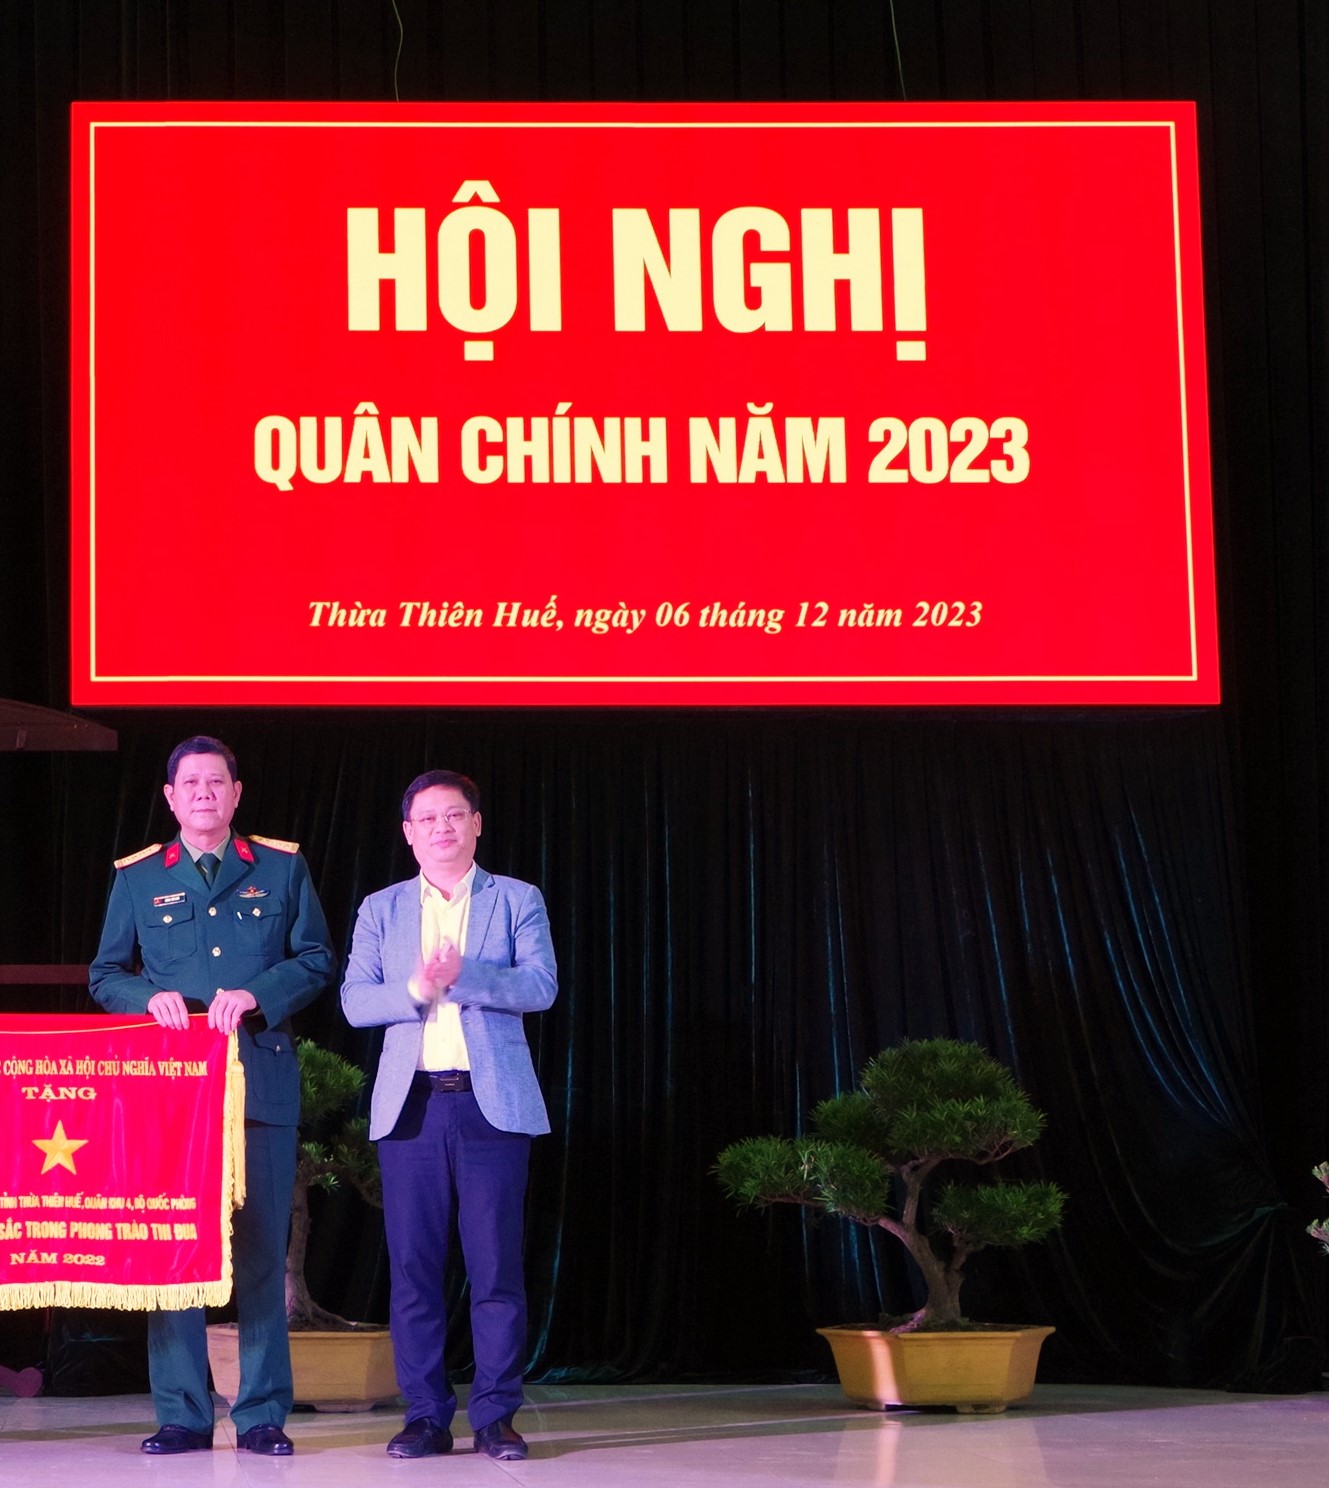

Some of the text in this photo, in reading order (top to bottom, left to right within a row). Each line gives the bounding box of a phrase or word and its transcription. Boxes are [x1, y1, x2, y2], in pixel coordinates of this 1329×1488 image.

[346, 179, 927, 362] HỘI NGHỊ
[254, 401, 1031, 492] QUÂN CHÍNH NĂM 2023
[309, 594, 983, 635] Thừa Thiên Huế, ngày 06 tháng 12 năm 2023
[3, 1055, 33, 1080] CỘNG
[35, 1055, 58, 1075] HÒA
[76, 1055, 96, 1080] HỘI
[97, 1054, 120, 1076] CHỦ
[122, 1056, 156, 1076] NGHĨA
[157, 1057, 183, 1080] VIỆT
[184, 1061, 208, 1076] NAM
[21, 1083, 97, 1102] TẶNG
[25, 1221, 68, 1239] TRONG
[69, 1221, 113, 1240] PHONG
[115, 1219, 149, 1241] TRÀO
[150, 1222, 172, 1241] THI
[173, 1223, 198, 1241] ĐUA
[10, 1249, 106, 1267] NĂM 2022
